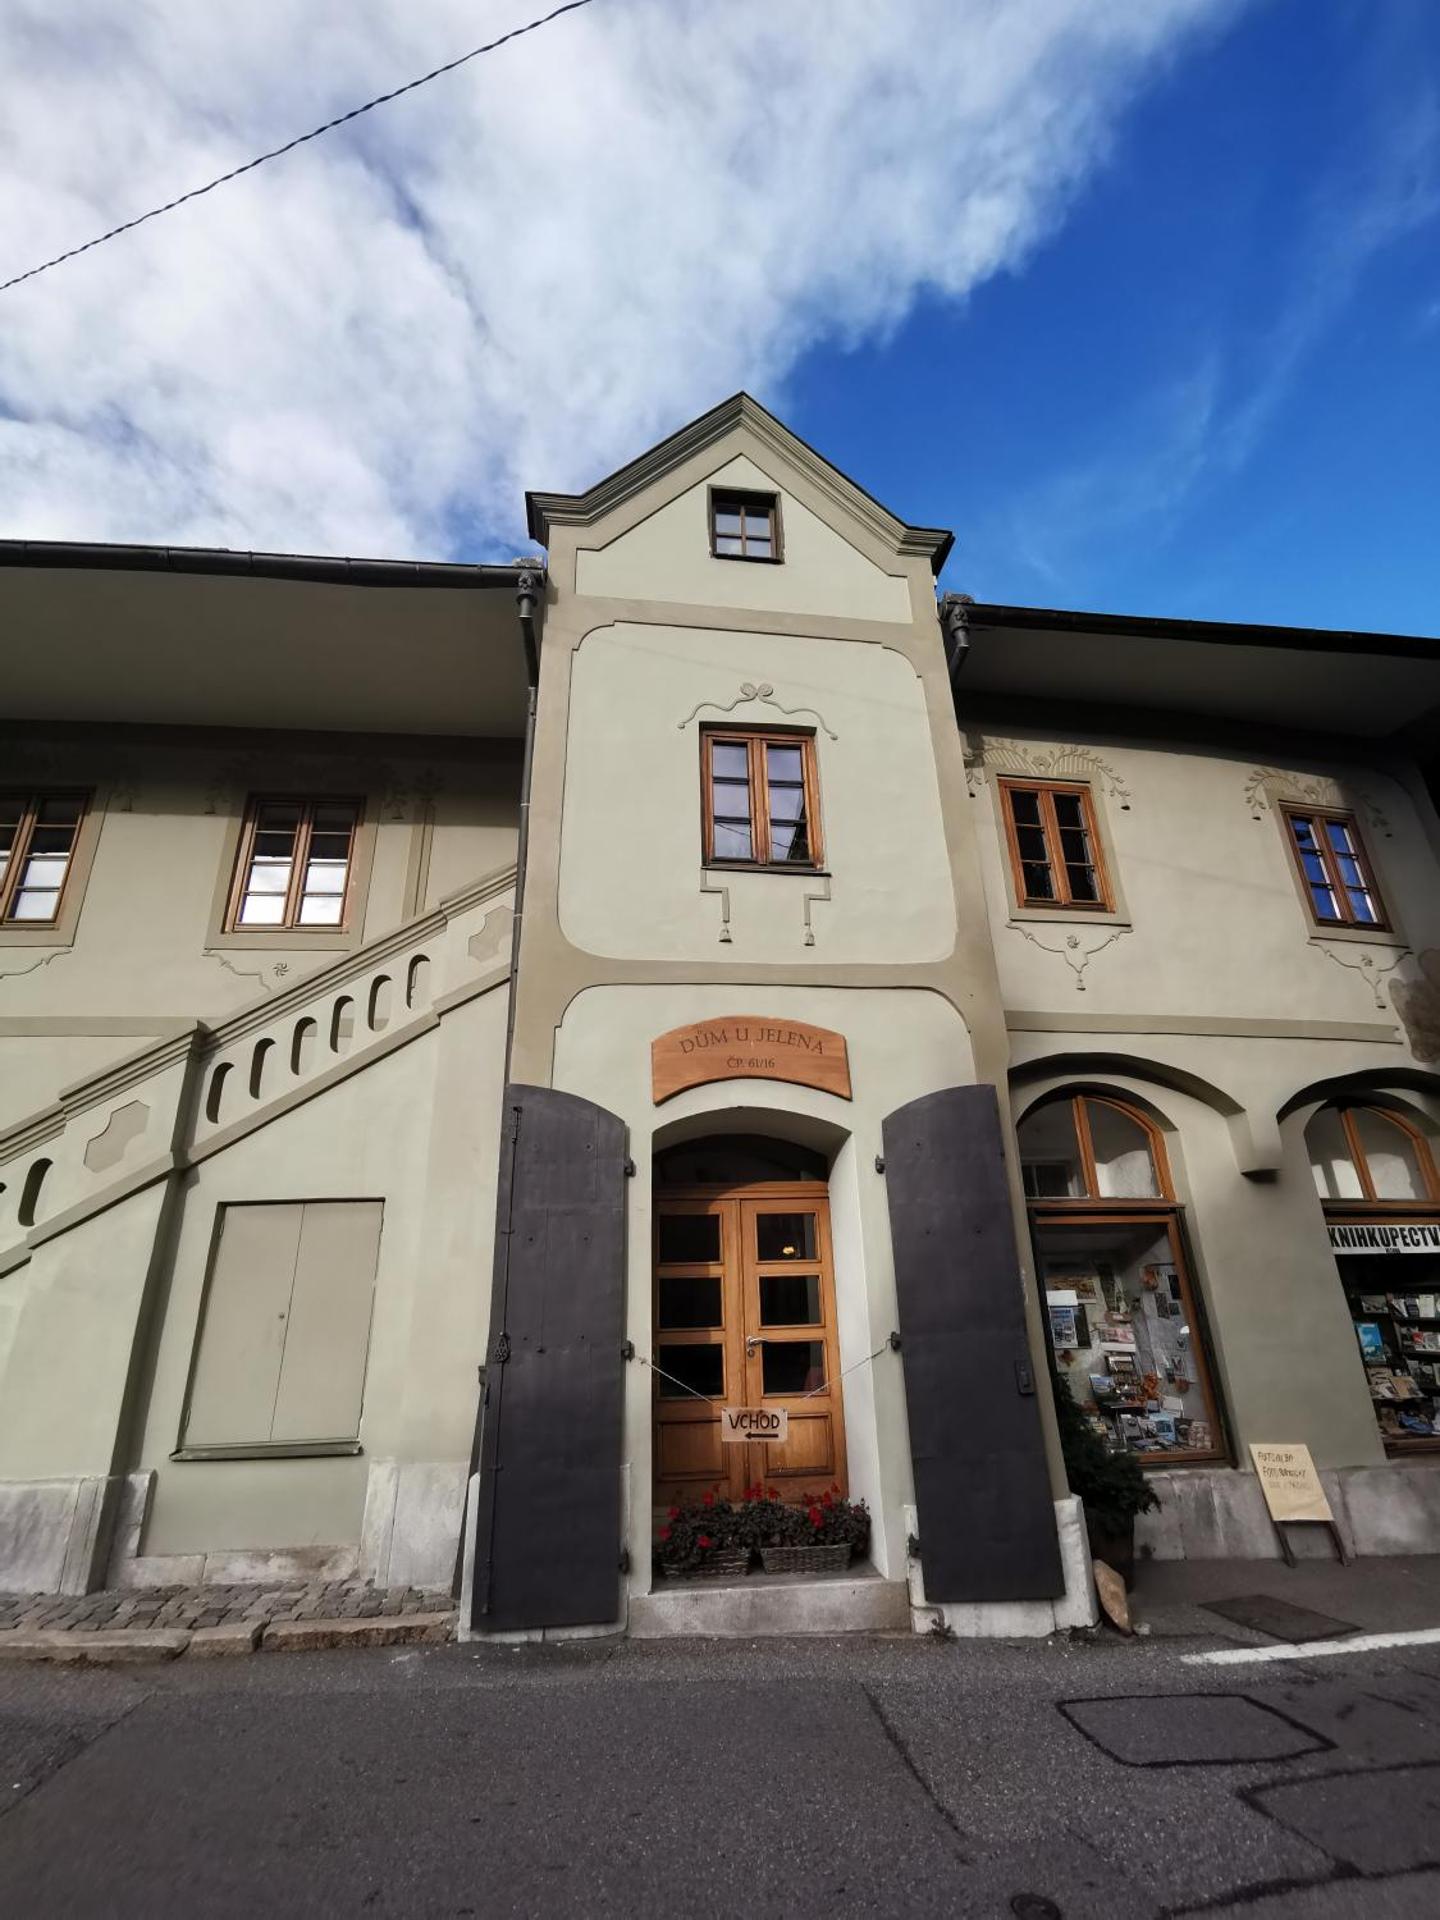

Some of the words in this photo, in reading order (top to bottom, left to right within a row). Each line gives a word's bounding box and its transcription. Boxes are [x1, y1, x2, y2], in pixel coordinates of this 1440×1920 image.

[736, 1028, 749, 1042] U
[757, 1027, 824, 1055] JELENA
[1327, 1227, 1440, 1248] KNIHKUPECTV
[728, 1414, 780, 1429] VCHOD
